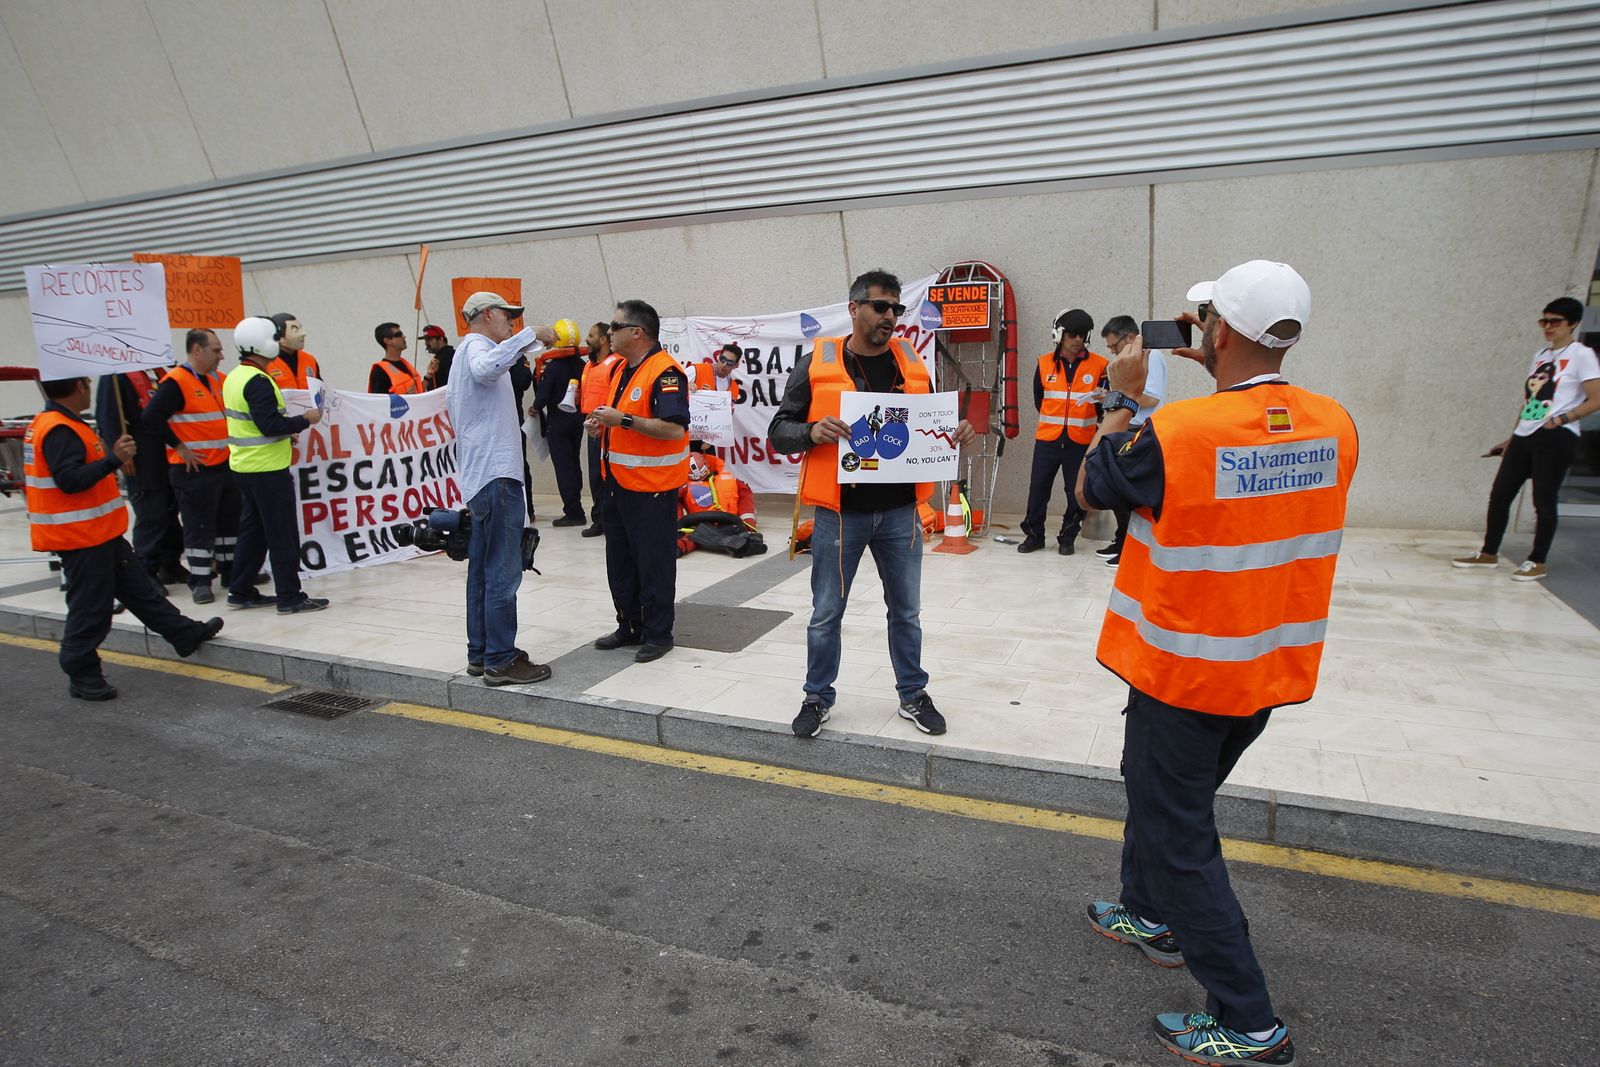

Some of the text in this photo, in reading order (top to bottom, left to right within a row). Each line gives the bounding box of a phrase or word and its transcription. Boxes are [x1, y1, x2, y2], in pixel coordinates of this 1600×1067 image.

[197, 255, 225, 270] LOS
[40, 269, 145, 297] RECORTES
[929, 285, 988, 302] SE VENDE
[105, 299, 133, 319] EN
[65, 337, 144, 364] SALVAMENTO
[853, 434, 870, 448] BAD
[882, 433, 903, 448] COCK
[929, 445, 943, 453] 30%
[906, 457, 920, 465] NO,
[921, 456, 936, 464] YOU
[1220, 445, 1336, 471] Salvamento
[1235, 468, 1324, 494] Marítimo
[302, 476, 463, 536] PERSONA
